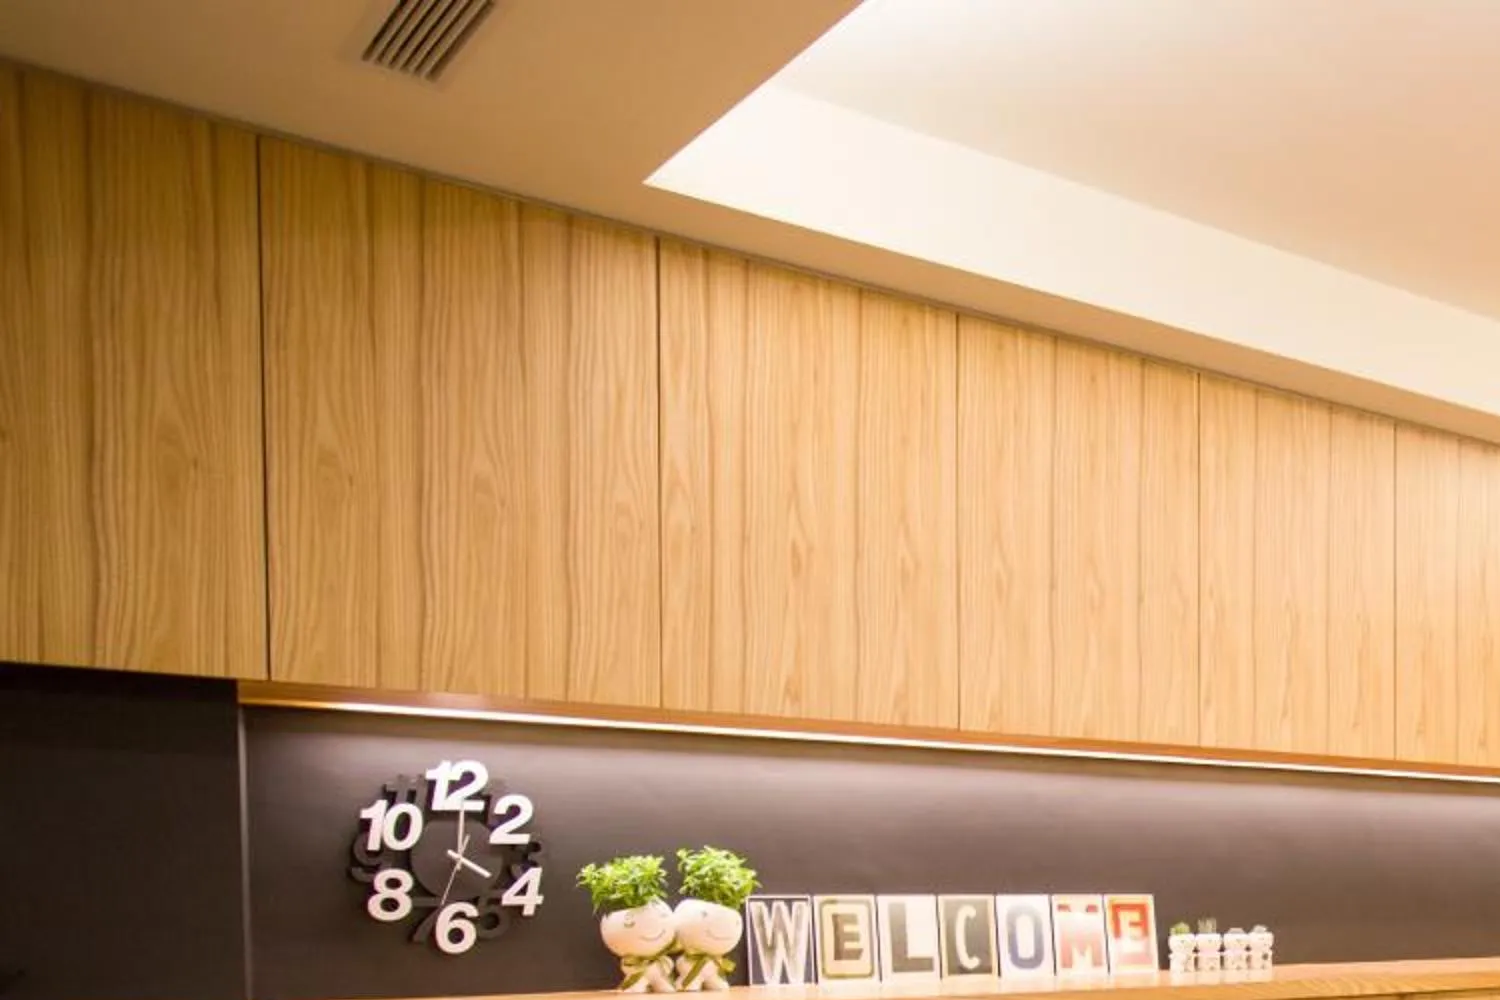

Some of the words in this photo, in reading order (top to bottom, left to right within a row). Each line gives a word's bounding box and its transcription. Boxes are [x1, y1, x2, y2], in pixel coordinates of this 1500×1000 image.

[426, 760, 488, 811] 12
[360, 799, 423, 851] 10
[489, 794, 533, 844] 2
[367, 869, 413, 922] 8
[501, 867, 544, 916] 4
[435, 902, 479, 954] 6
[752, 899, 1153, 985] WELCOME
